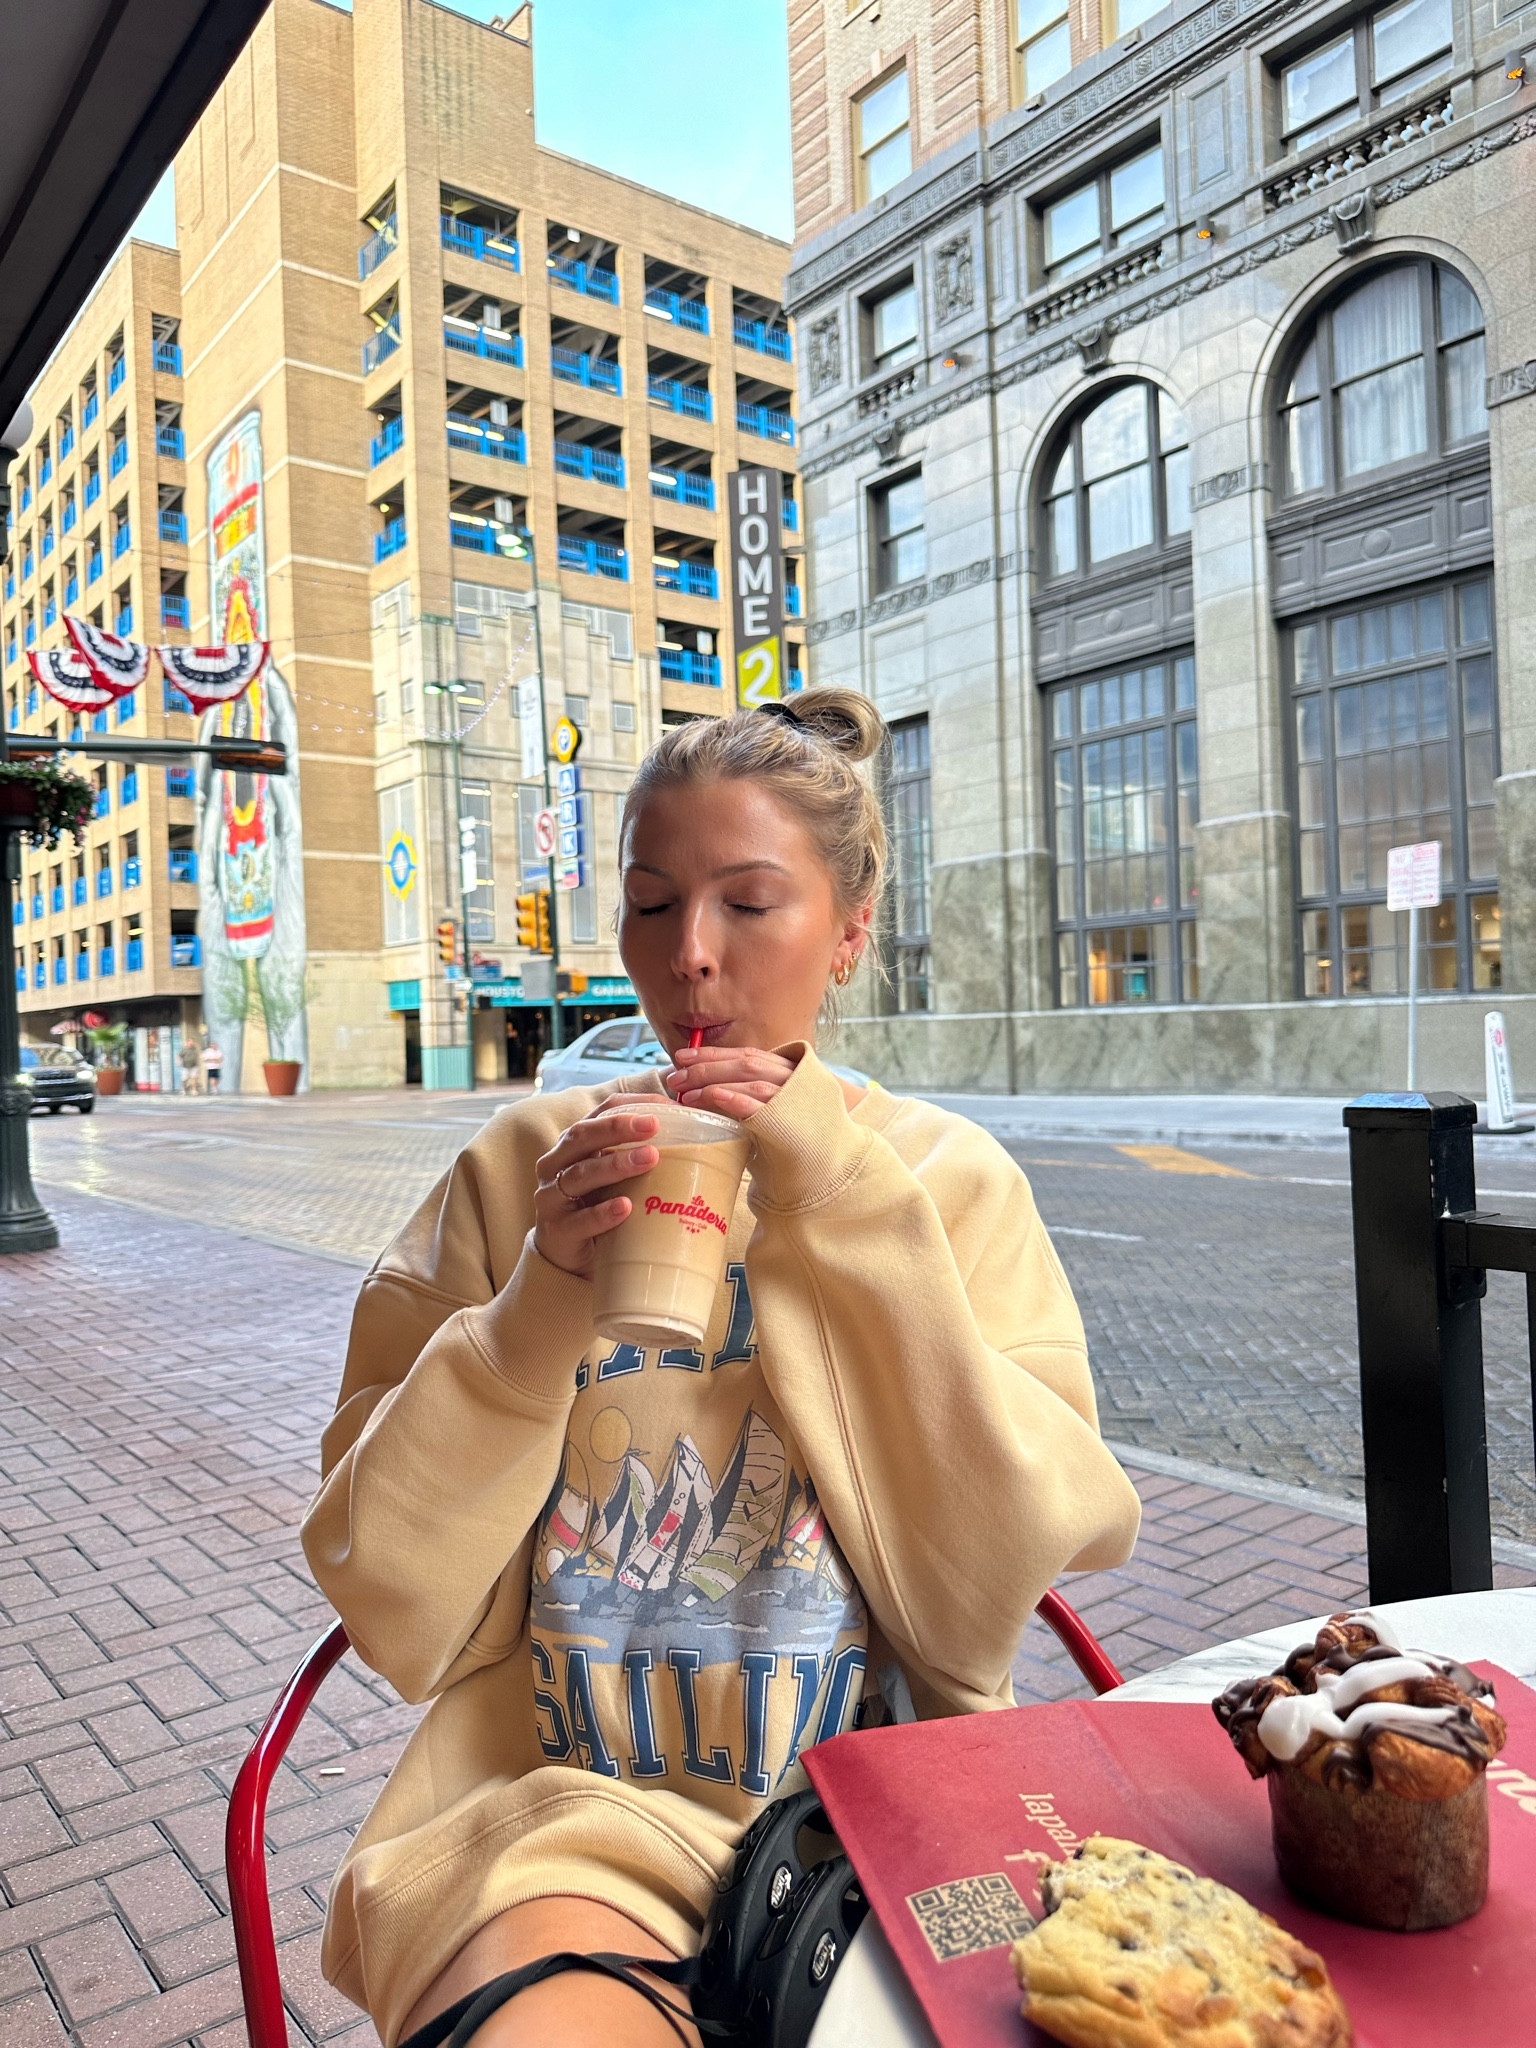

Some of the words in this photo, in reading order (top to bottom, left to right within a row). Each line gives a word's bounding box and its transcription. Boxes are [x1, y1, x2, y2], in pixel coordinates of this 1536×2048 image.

[738, 473, 773, 637] HOME
[743, 647, 781, 706] 2
[691, 1195, 705, 1207] La
